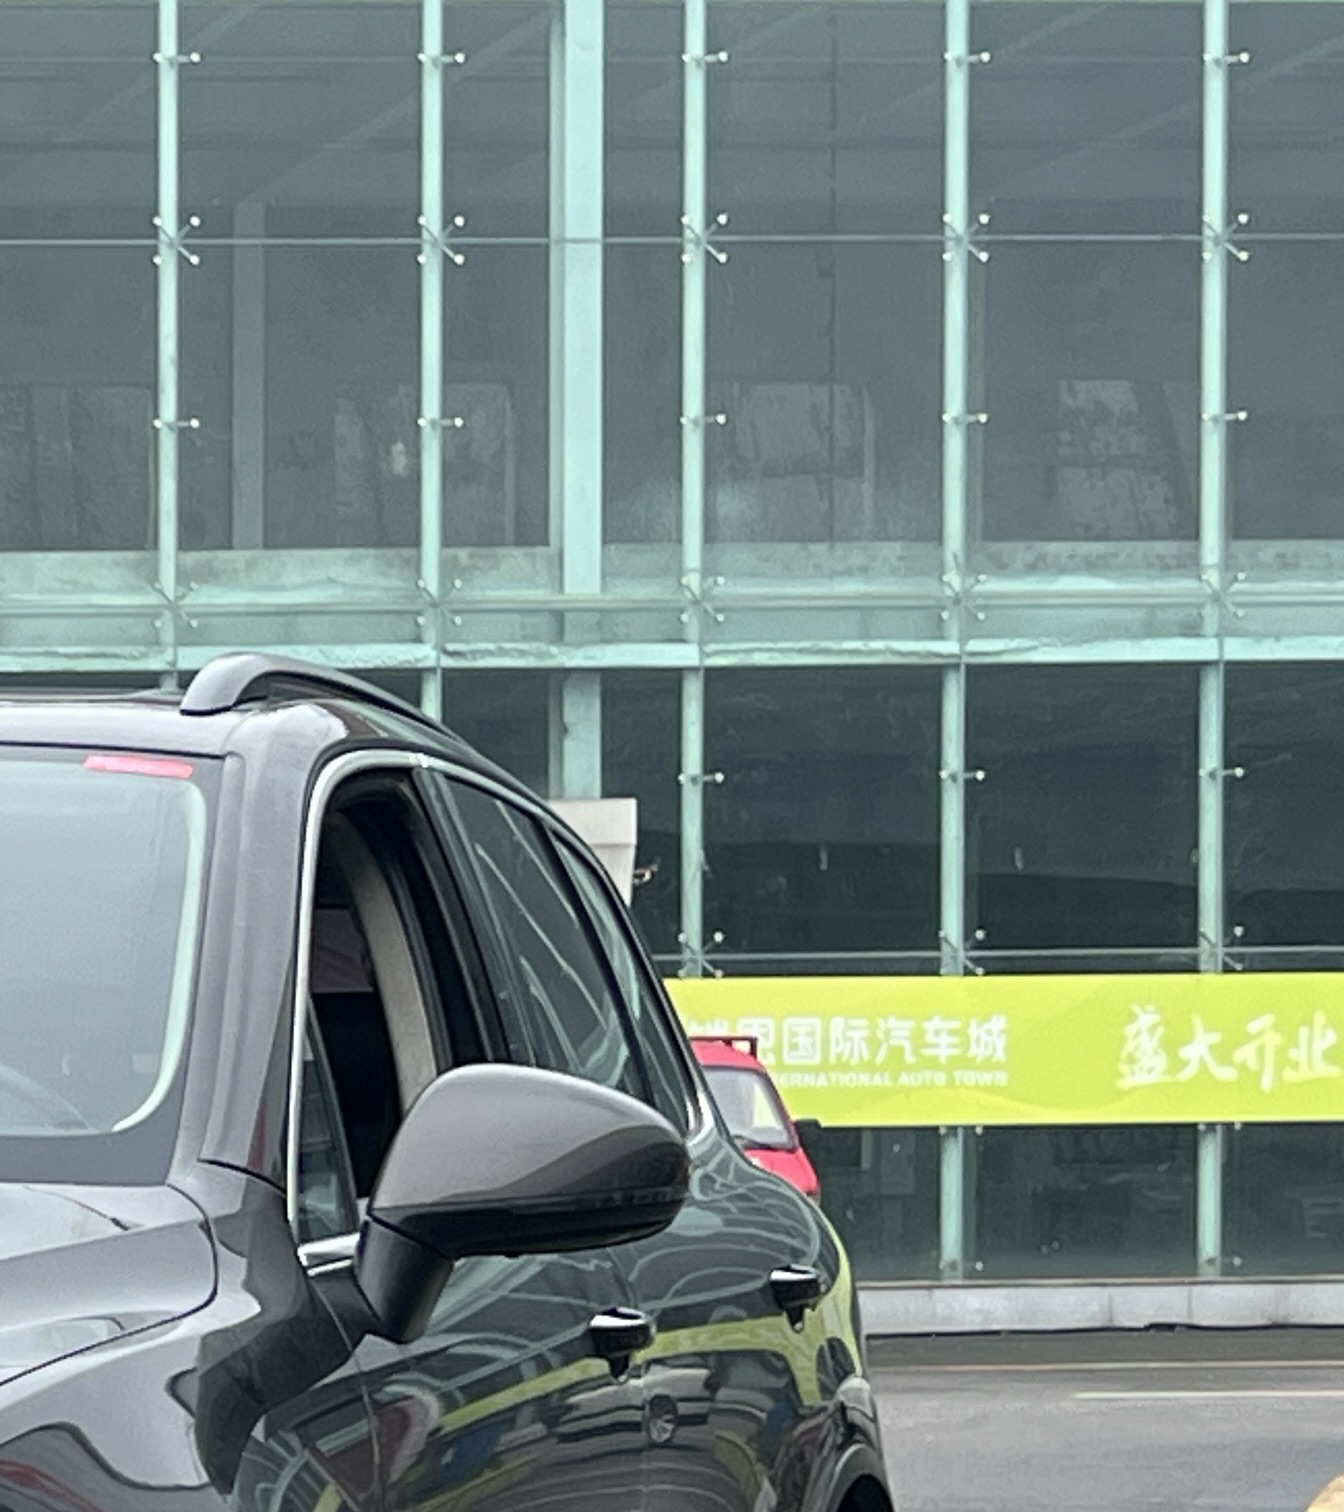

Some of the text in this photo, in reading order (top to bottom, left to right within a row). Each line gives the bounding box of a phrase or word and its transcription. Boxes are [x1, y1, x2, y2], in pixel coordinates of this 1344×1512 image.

[1116, 1002, 1342, 1094] 盛大开业
[898, 1070, 946, 1087] AUTO
[953, 1070, 1008, 1087] TOWN
